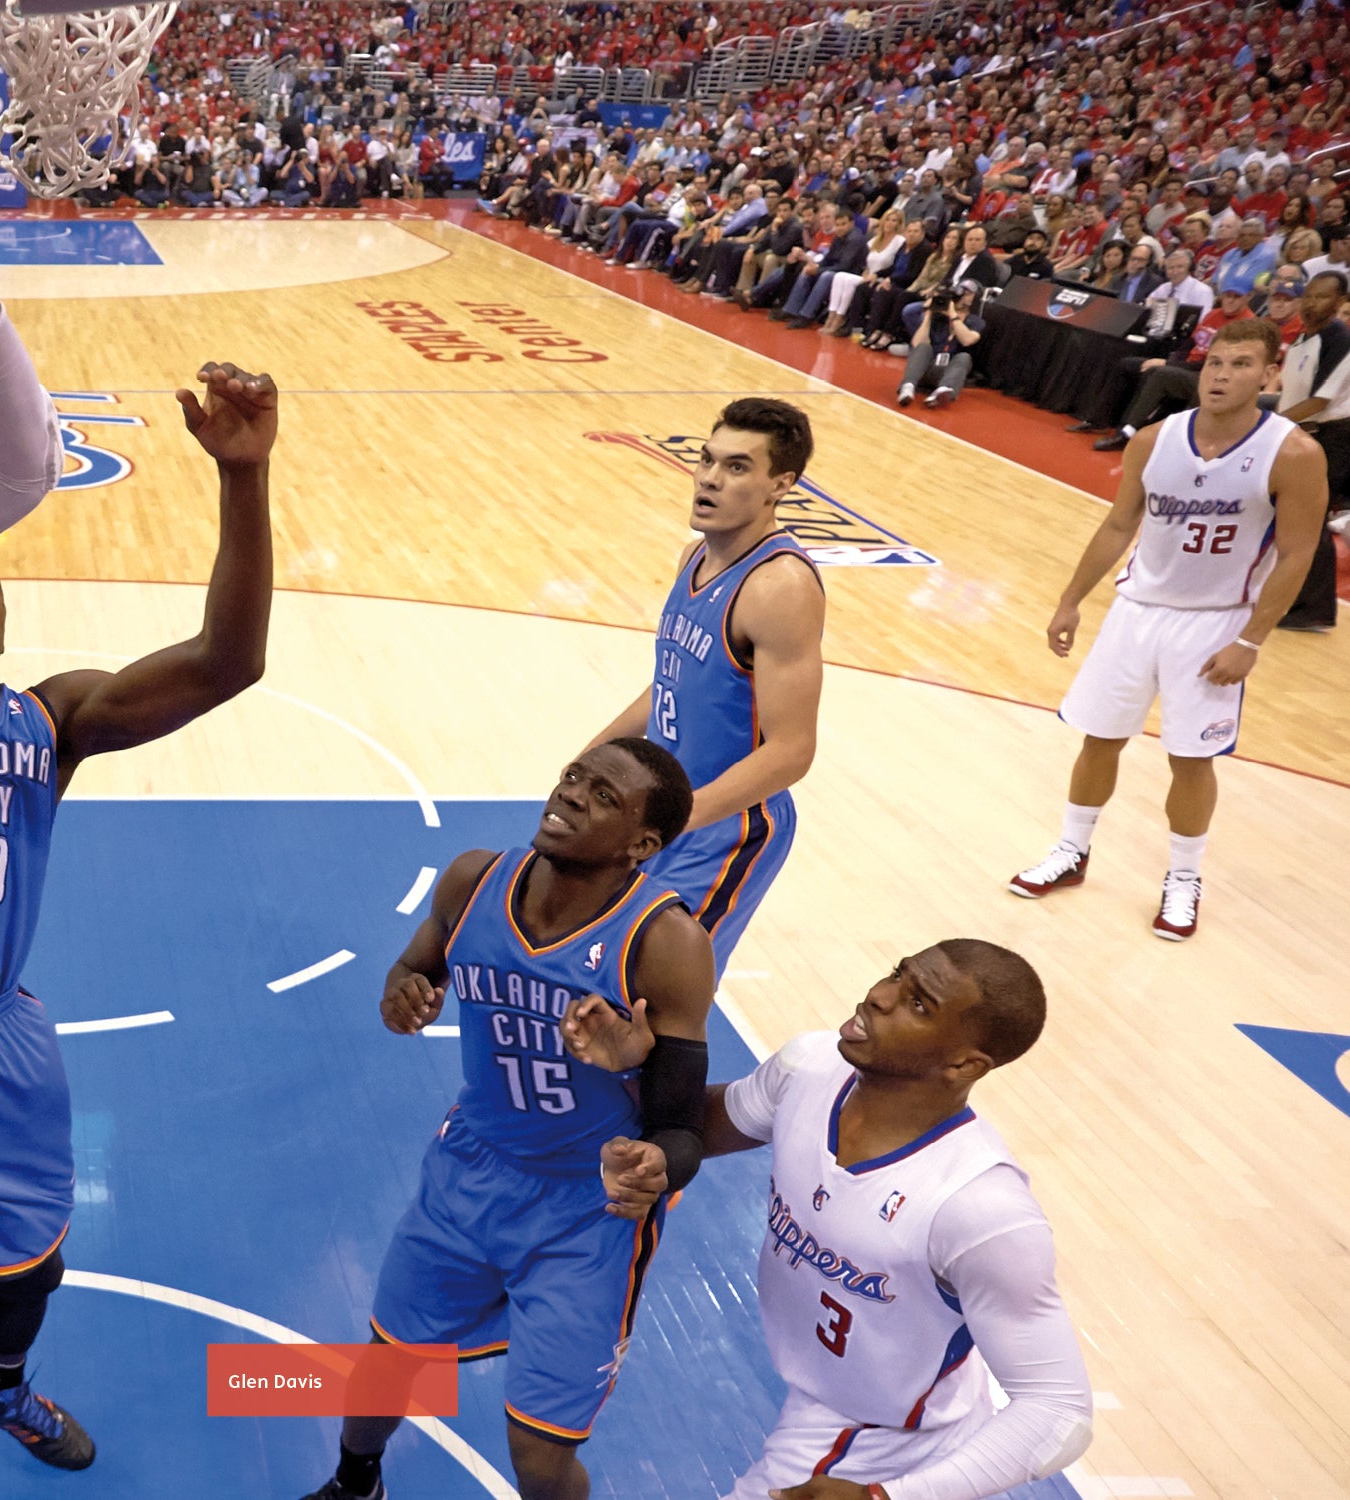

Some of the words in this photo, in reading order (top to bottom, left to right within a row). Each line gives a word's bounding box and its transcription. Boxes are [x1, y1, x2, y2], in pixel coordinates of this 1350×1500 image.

[355, 300, 505, 363] STAPLES
[454, 301, 609, 363] Center
[1148, 492, 1246, 525] Clippers
[1182, 522, 1238, 555] 32
[655, 683, 678, 742] 12
[453, 964, 573, 1019] OKLAHO
[492, 1013, 564, 1057] CITY
[496, 1056, 576, 1115] 15
[768, 1175, 897, 1304] lippers
[816, 1290, 853, 1358] 3
